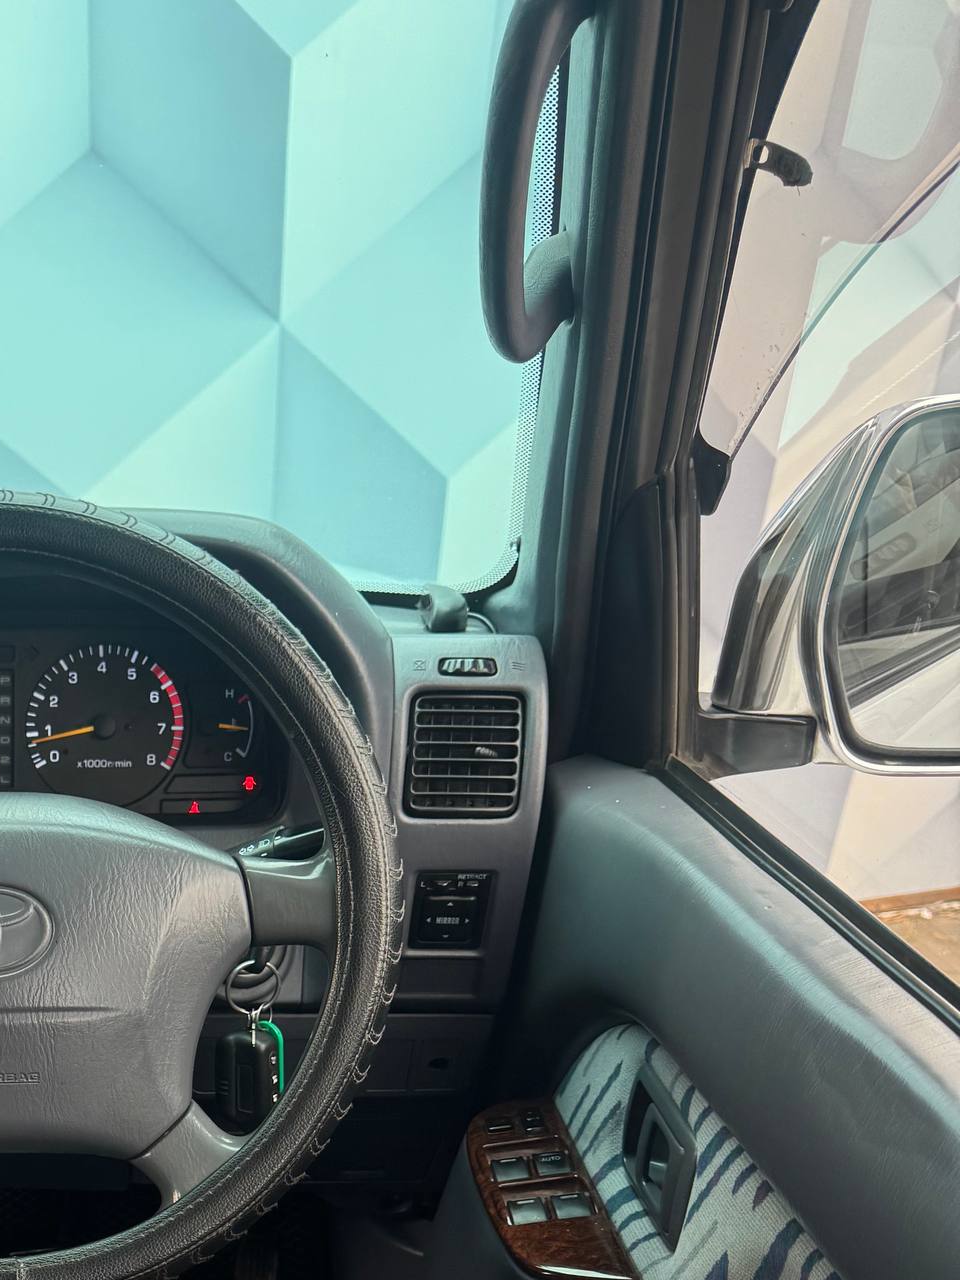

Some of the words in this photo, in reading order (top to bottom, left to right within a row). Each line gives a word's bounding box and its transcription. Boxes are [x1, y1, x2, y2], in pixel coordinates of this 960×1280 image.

[97, 662, 107, 673] 4
[68, 672, 79, 684] 3
[127, 668, 137, 680] 5
[149, 691, 160, 704] 6
[225, 689, 234, 698] H
[49, 696, 59, 708] 2
[44, 724, 52, 736] 1
[157, 723, 167, 735] 7
[49, 750, 59, 762] 0
[146, 754, 156, 766] 8
[224, 752, 232, 761] C
